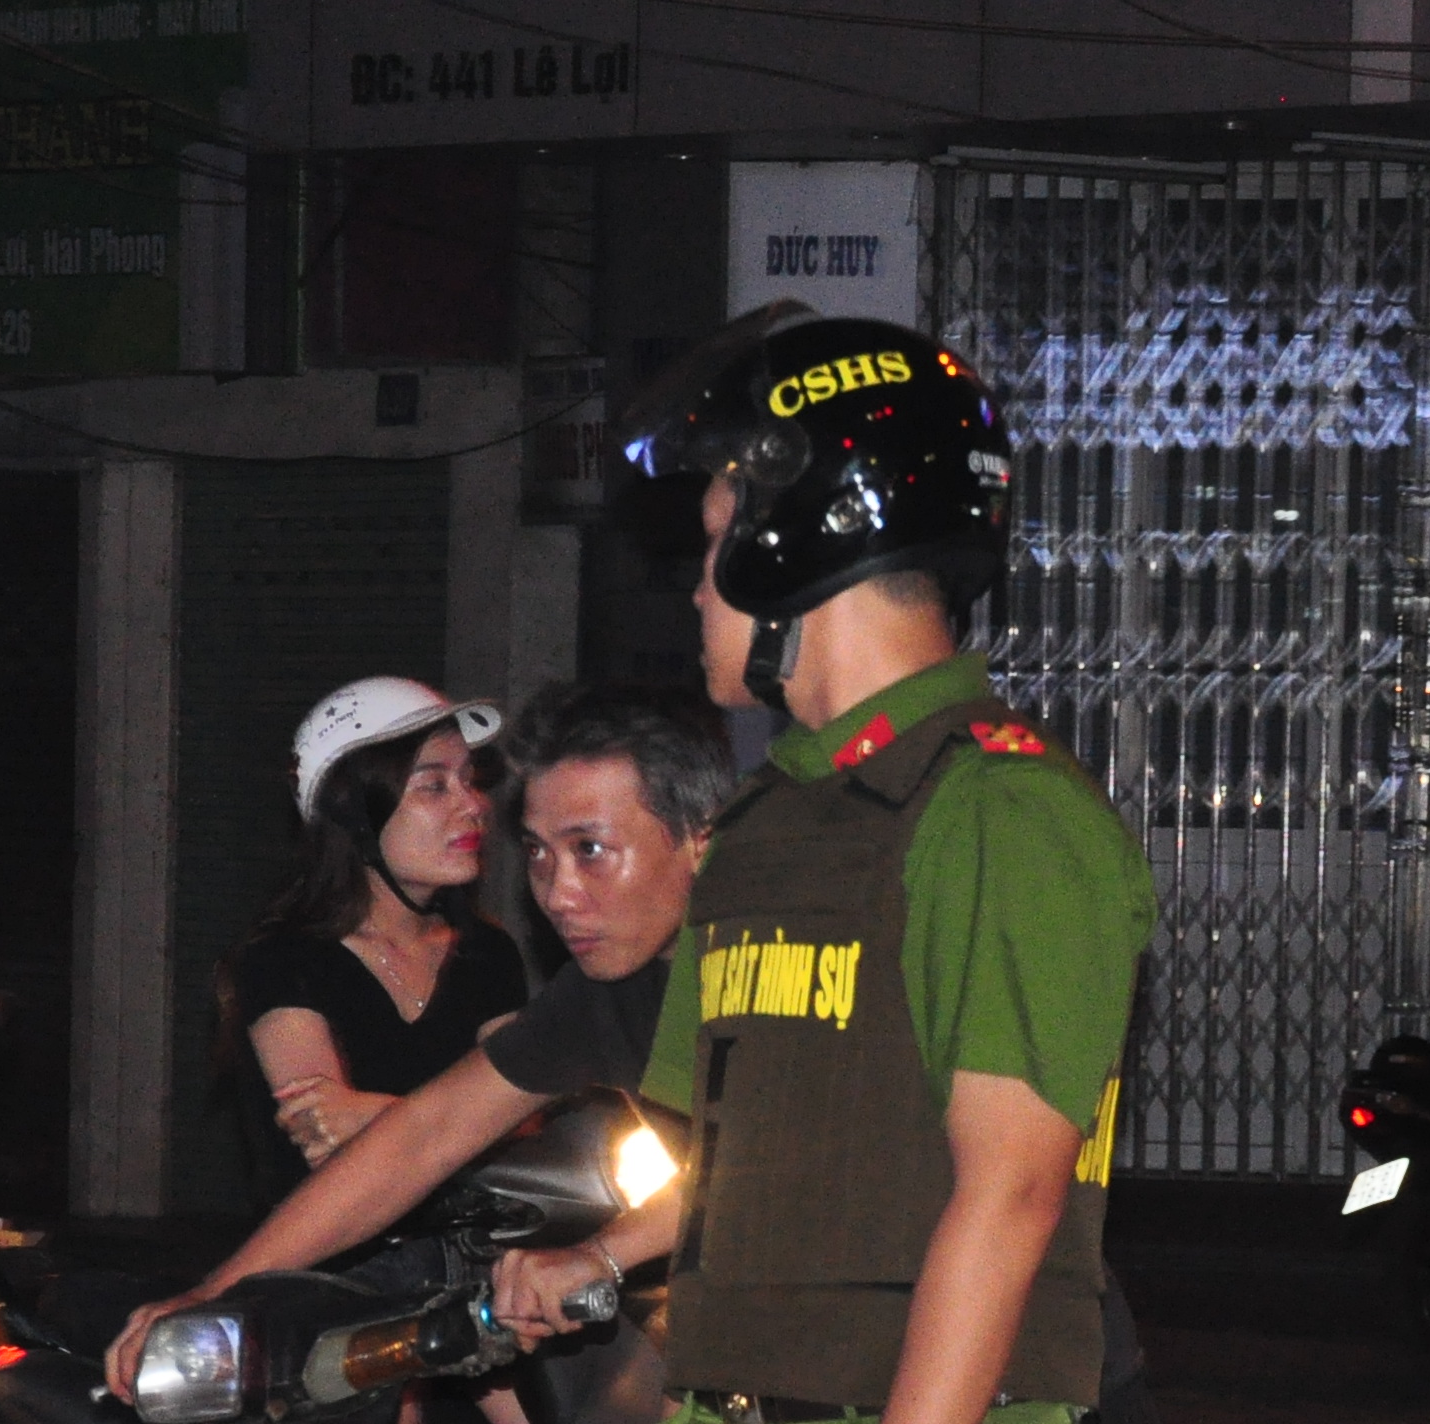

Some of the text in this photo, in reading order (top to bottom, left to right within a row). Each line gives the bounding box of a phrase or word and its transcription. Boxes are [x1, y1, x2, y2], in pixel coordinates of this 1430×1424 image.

[428, 50, 495, 100] 441
[513, 45, 557, 98] Lê
[571, 43, 631, 104] Lợi
[766, 225, 879, 277] ĐỨC HUY
[768, 350, 912, 418] CSHS
[720, 929, 761, 1017] SÁT
[752, 926, 816, 1017] HÌNH
[814, 940, 861, 1031] SỰ
